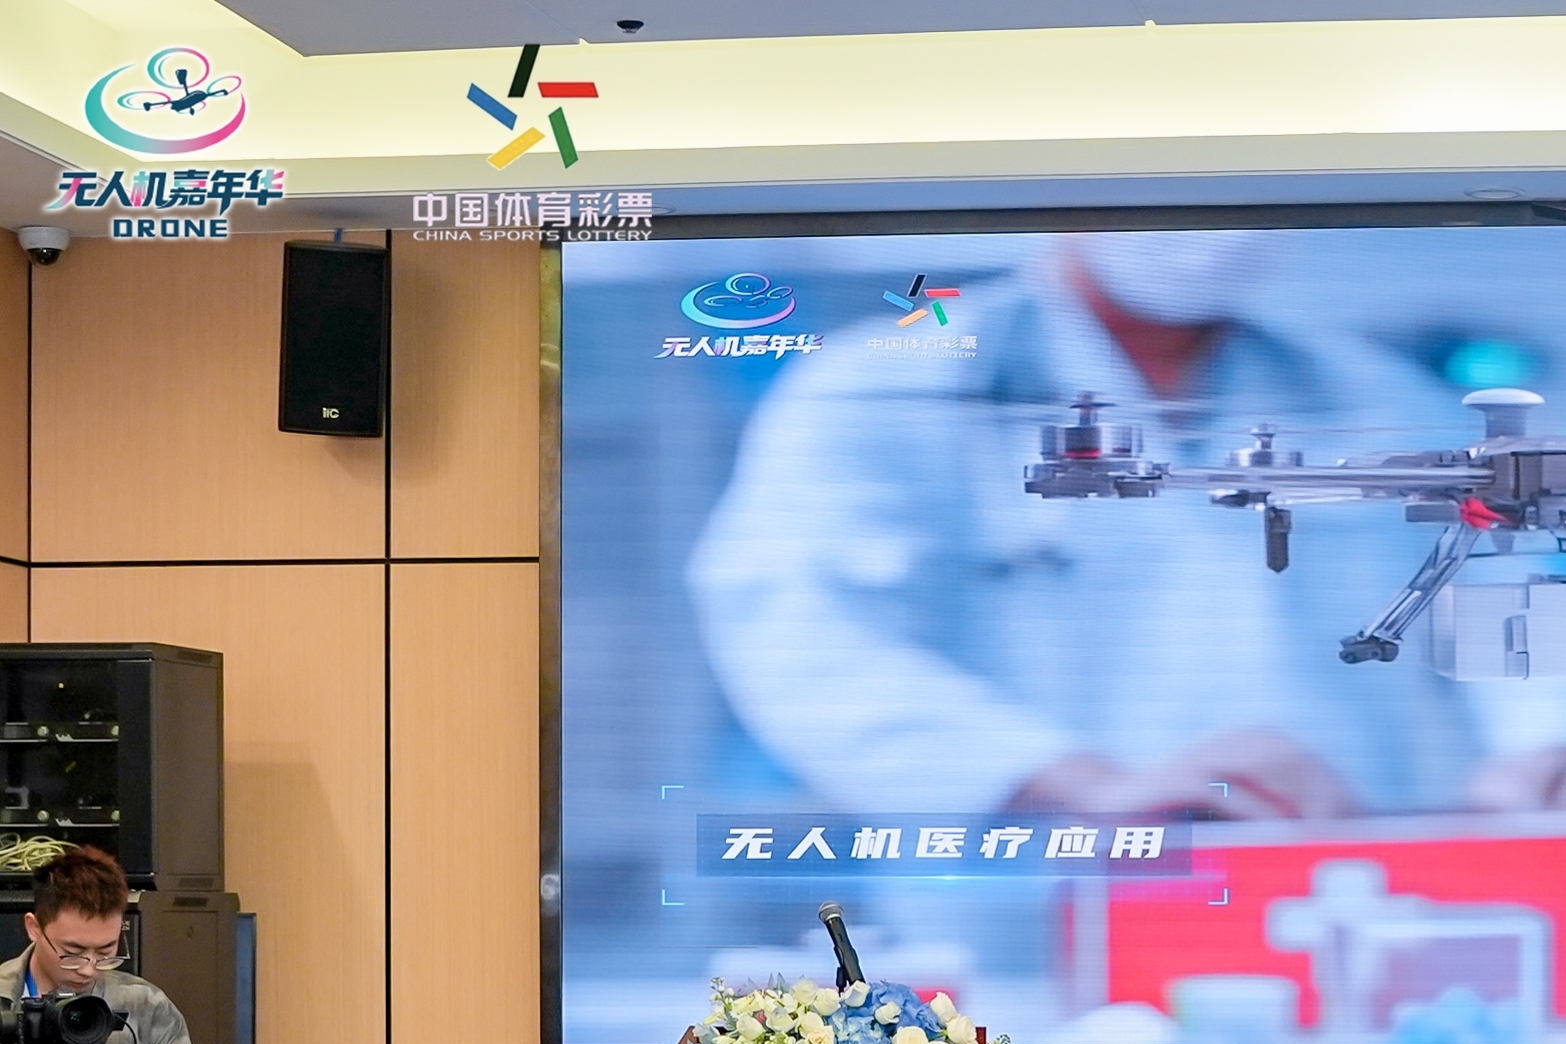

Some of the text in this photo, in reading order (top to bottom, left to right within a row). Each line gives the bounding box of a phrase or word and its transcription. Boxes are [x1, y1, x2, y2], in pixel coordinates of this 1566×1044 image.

[653, 334, 824, 360] 无人机嘉年华
[721, 826, 1166, 860] 无人机医疗应用
